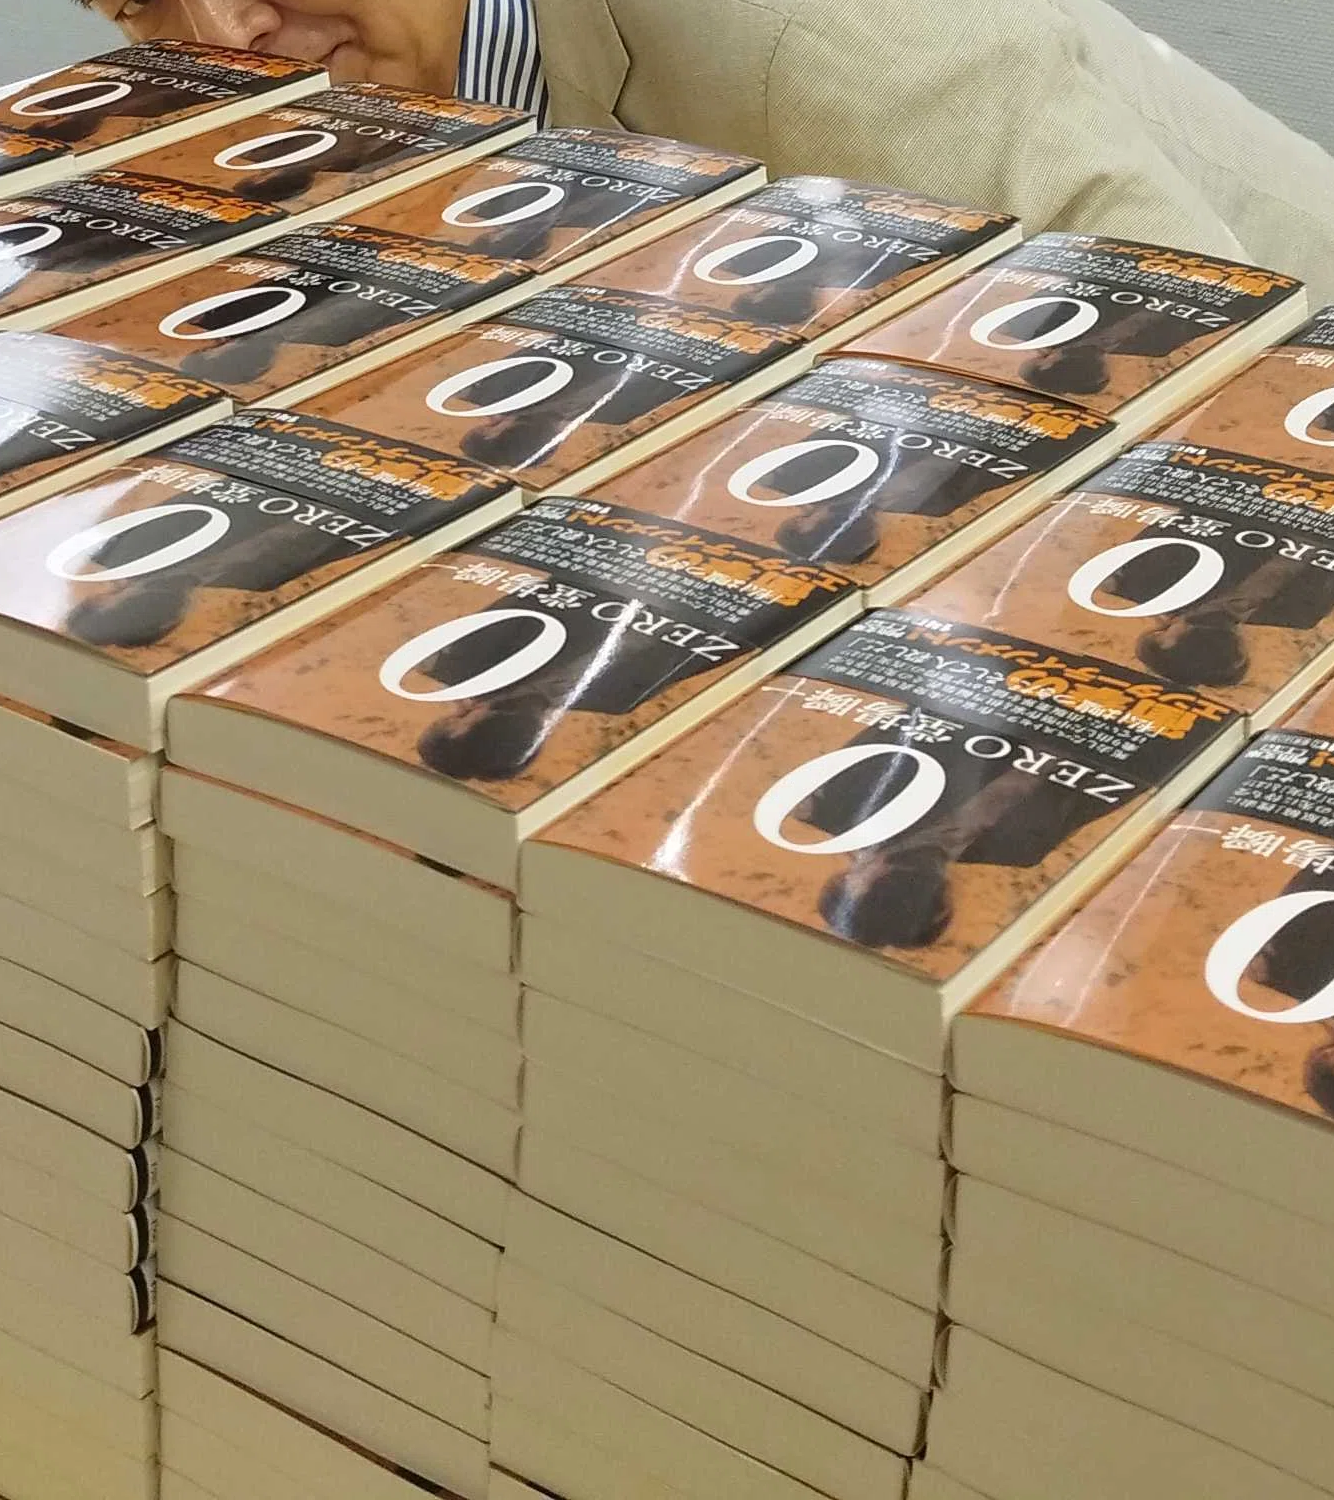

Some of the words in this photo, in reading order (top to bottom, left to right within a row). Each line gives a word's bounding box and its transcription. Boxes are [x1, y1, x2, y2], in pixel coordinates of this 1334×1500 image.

[10, 82, 131, 115] 0
[213, 130, 336, 169] 0
[355, 125, 449, 150] ZERO
[440, 182, 565, 226] 0
[582, 176, 683, 202] ZERO
[85, 218, 190, 247] ZERO
[833, 230, 945, 260] ZERO
[692, 236, 817, 284] 0
[158, 287, 305, 339] 0
[327, 280, 441, 315] ZERO
[1111, 291, 1233, 327] ZERO
[969, 297, 1097, 349] 0
[424, 356, 572, 416] 0
[593, 349, 717, 389] ZERO
[726, 440, 878, 506] 0
[893, 434, 1031, 478] ZERO
[113, 463, 270, 504] 堂場瞬一
[45, 504, 229, 581] 0
[257, 497, 395, 547] ZERO
[427, 560, 596, 609] 堂場瞬一
[1067, 538, 1223, 616] 0
[590, 601, 742, 660] ZERO
[378, 609, 565, 701] 0
[762, 686, 963, 744] 堂場瞬一
[966, 734, 1136, 802] ZERO
[753, 744, 944, 853] 0
